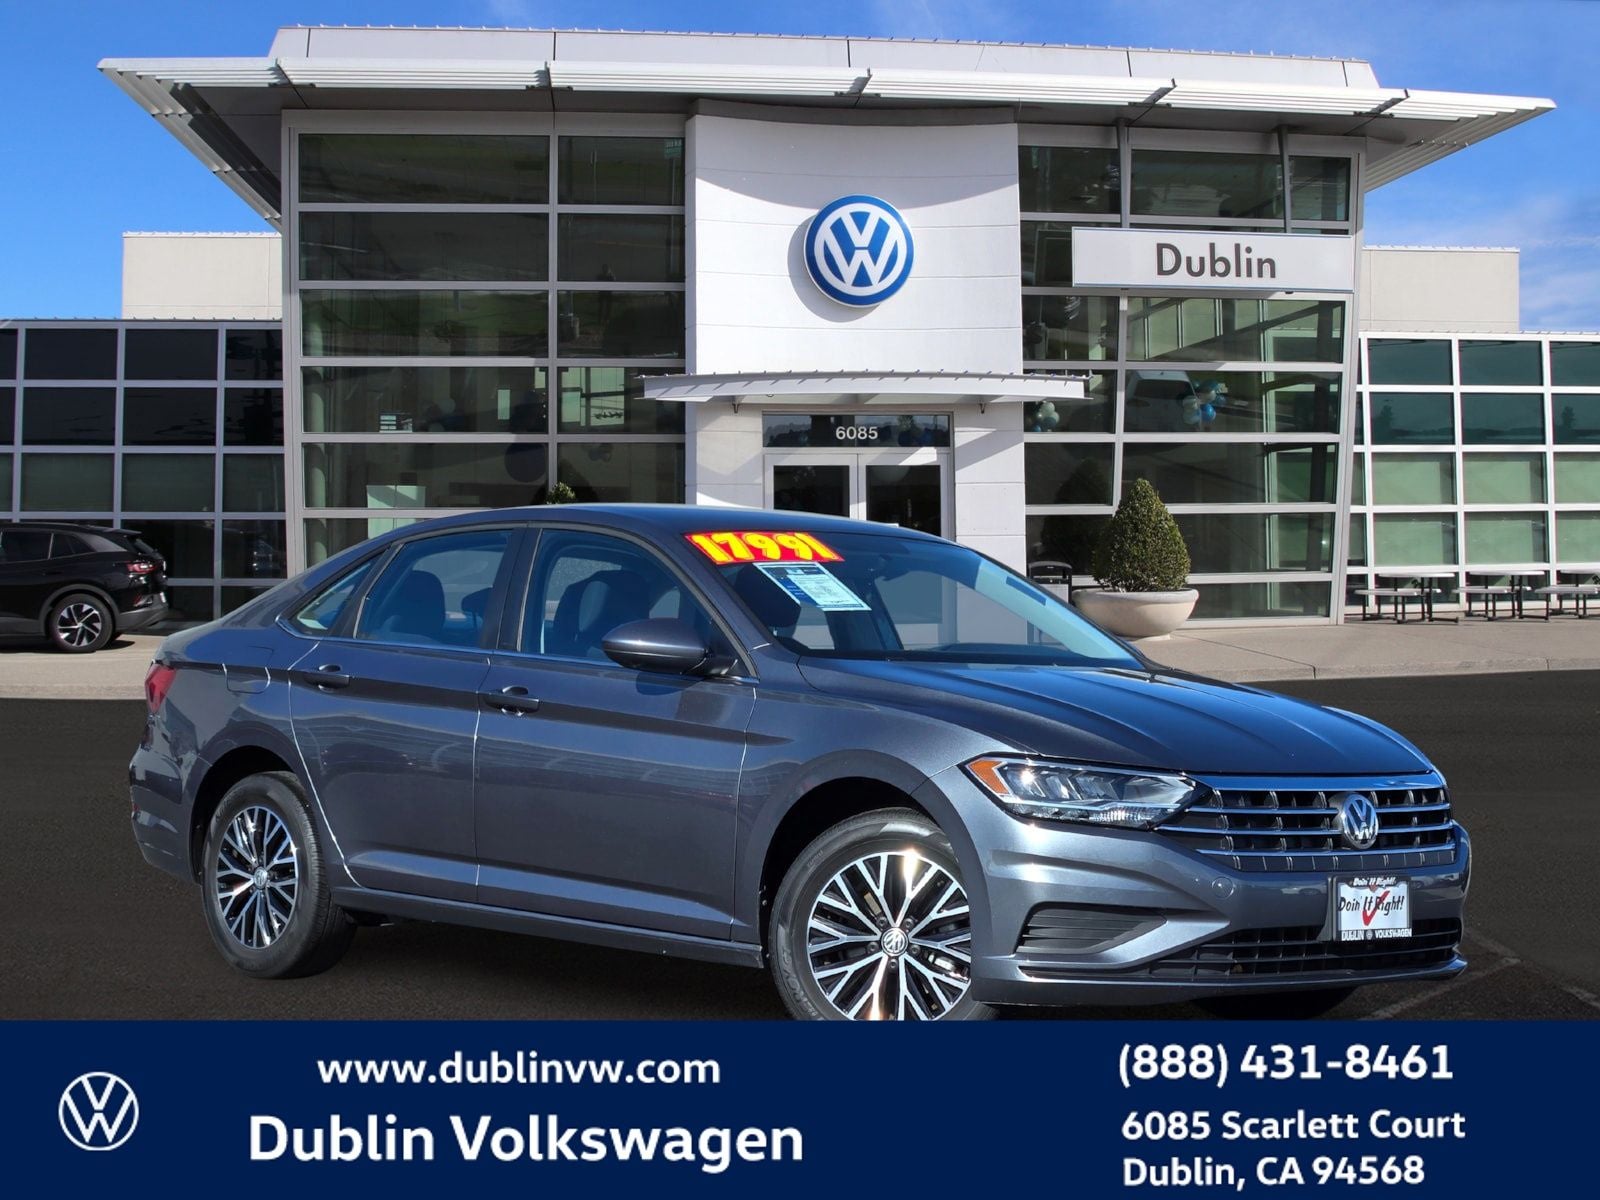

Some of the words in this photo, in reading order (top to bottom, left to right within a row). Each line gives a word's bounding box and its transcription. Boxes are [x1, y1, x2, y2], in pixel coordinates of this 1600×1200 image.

[1156, 242, 1276, 279] Dublin
[835, 426, 878, 440] 6085
[690, 531, 840, 562] 17991
[1363, 896, 1374, 911] It
[1375, 895, 1405, 916] Right!
[1341, 929, 1365, 941] DUBLIN
[1375, 928, 1412, 938] VOLKSWAGEN
